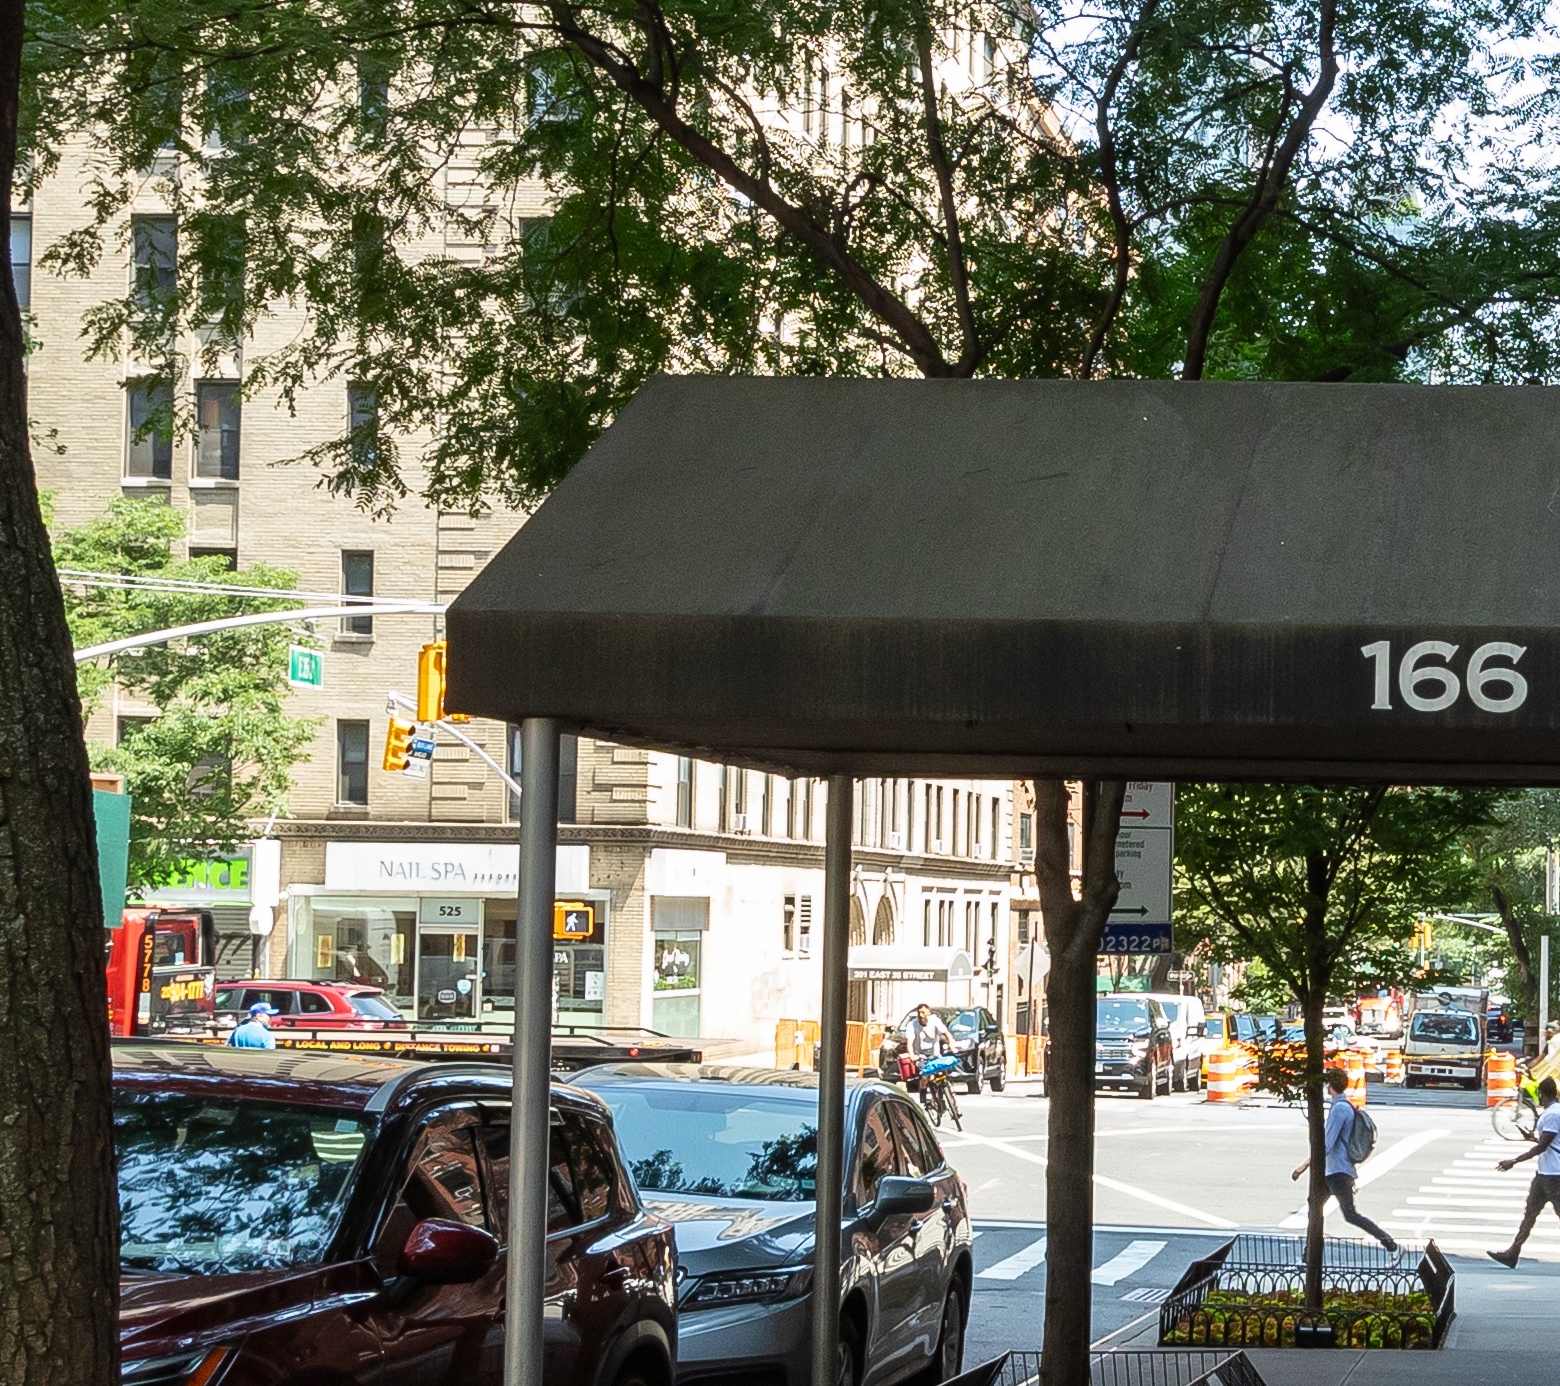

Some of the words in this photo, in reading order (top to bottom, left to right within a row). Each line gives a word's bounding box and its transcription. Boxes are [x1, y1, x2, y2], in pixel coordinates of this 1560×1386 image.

[1360, 640, 1528, 712] 166
[379, 860, 427, 880] NAIL
[430, 861, 467, 881] SPA
[439, 905, 462, 917] 525
[142, 934, 153, 992] 5778
[553, 951, 569, 964] PA
[868, 970, 891, 979] EAST
[903, 971, 935, 980] STREET
[295, 1040, 328, 1050] LOCAL
[329, 1041, 351, 1050] AND
[352, 1042, 381, 1051] LONG
[394, 1043, 441, 1052] DISTANCE
[443, 1044, 480, 1053] TOWING
